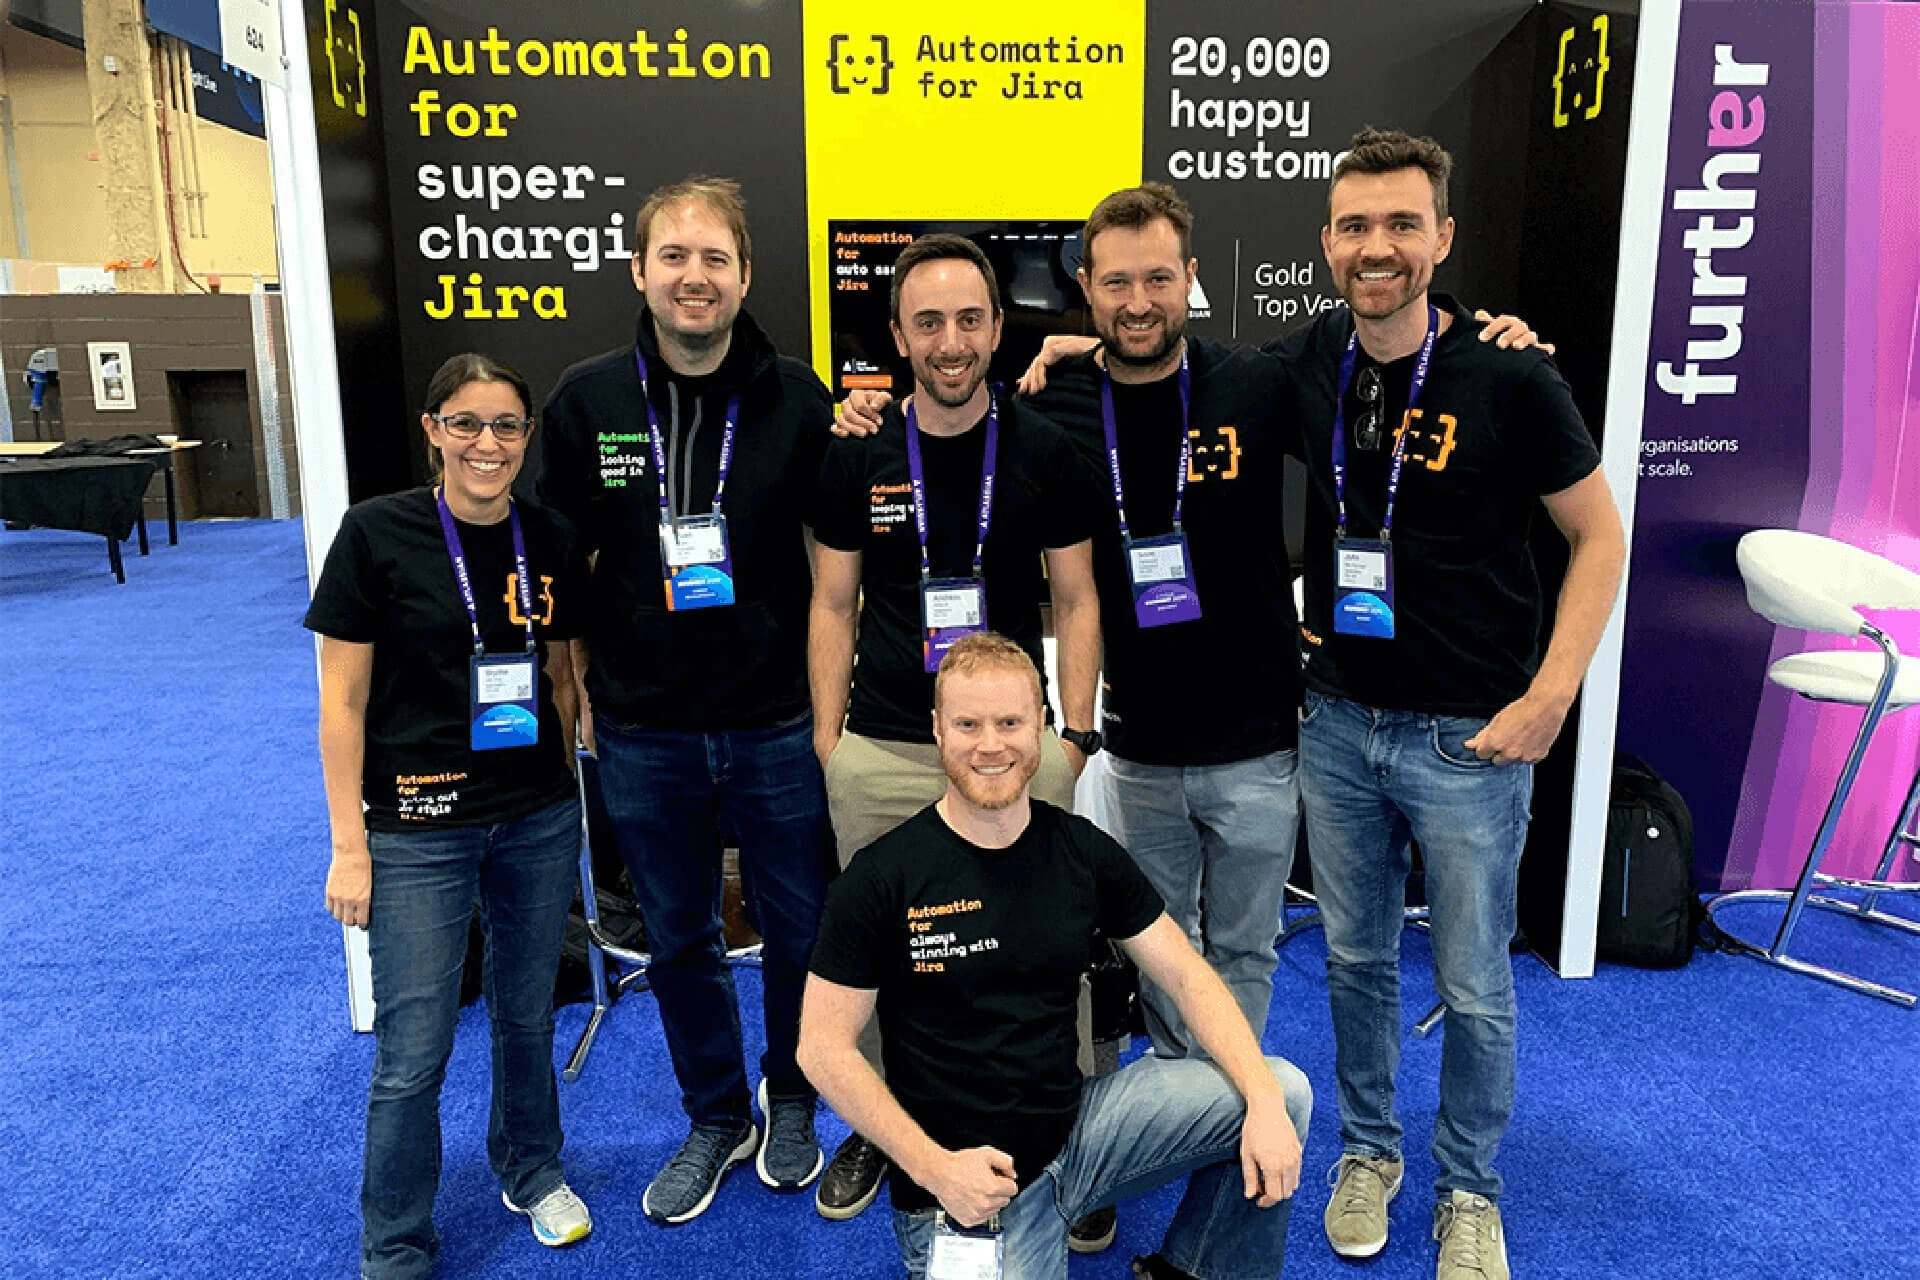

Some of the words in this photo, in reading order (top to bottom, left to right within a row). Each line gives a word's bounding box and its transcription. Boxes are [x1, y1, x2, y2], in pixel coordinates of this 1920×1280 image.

[404, 26, 770, 79] Automation
[917, 34, 1124, 63] Automation
[1171, 37, 1331, 83] 20,000
[918, 72, 978, 99] for
[1001, 72, 1084, 99] Jira
[411, 89, 518, 137] for
[1170, 88, 1310, 137] happy
[418, 162, 626, 210] super-
[418, 214, 633, 271] chargi
[835, 231, 913, 243] Automation
[836, 247, 860, 259] for
[836, 263, 869, 275] auto
[1255, 261, 1314, 287] Gold
[424, 275, 568, 320] Jira
[836, 279, 869, 290] Jira
[1253, 293, 1299, 322] Top
[597, 432, 651, 442] Automati
[1639, 436, 1739, 457] rganisations
[1648, 458, 1693, 476] scale.
[907, 899, 983, 920] Automation
